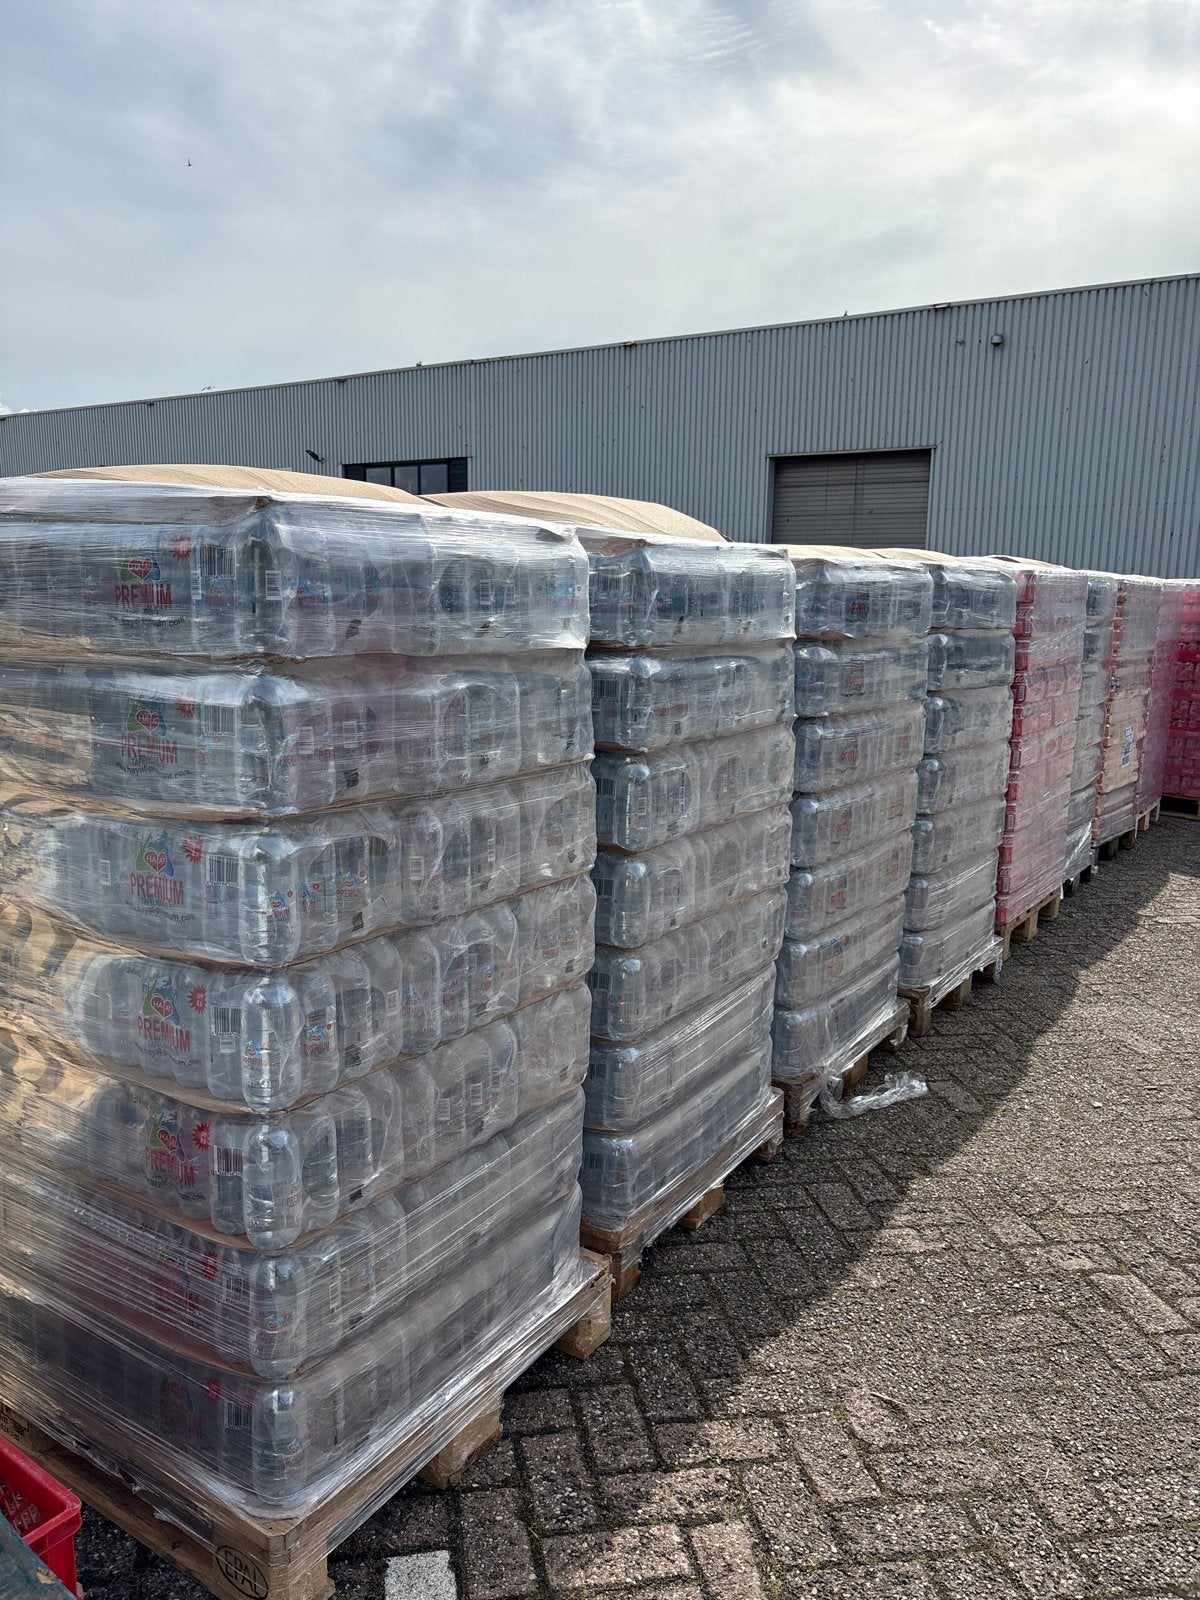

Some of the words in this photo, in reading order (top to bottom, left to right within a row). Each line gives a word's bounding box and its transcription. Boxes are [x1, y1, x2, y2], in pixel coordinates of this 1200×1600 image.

[115, 583, 173, 609] PREMIUM
[130, 872, 185, 906] PREMIUM
[138, 1016, 191, 1053] PREMIUM
[224, 1549, 261, 1597] EPAL
